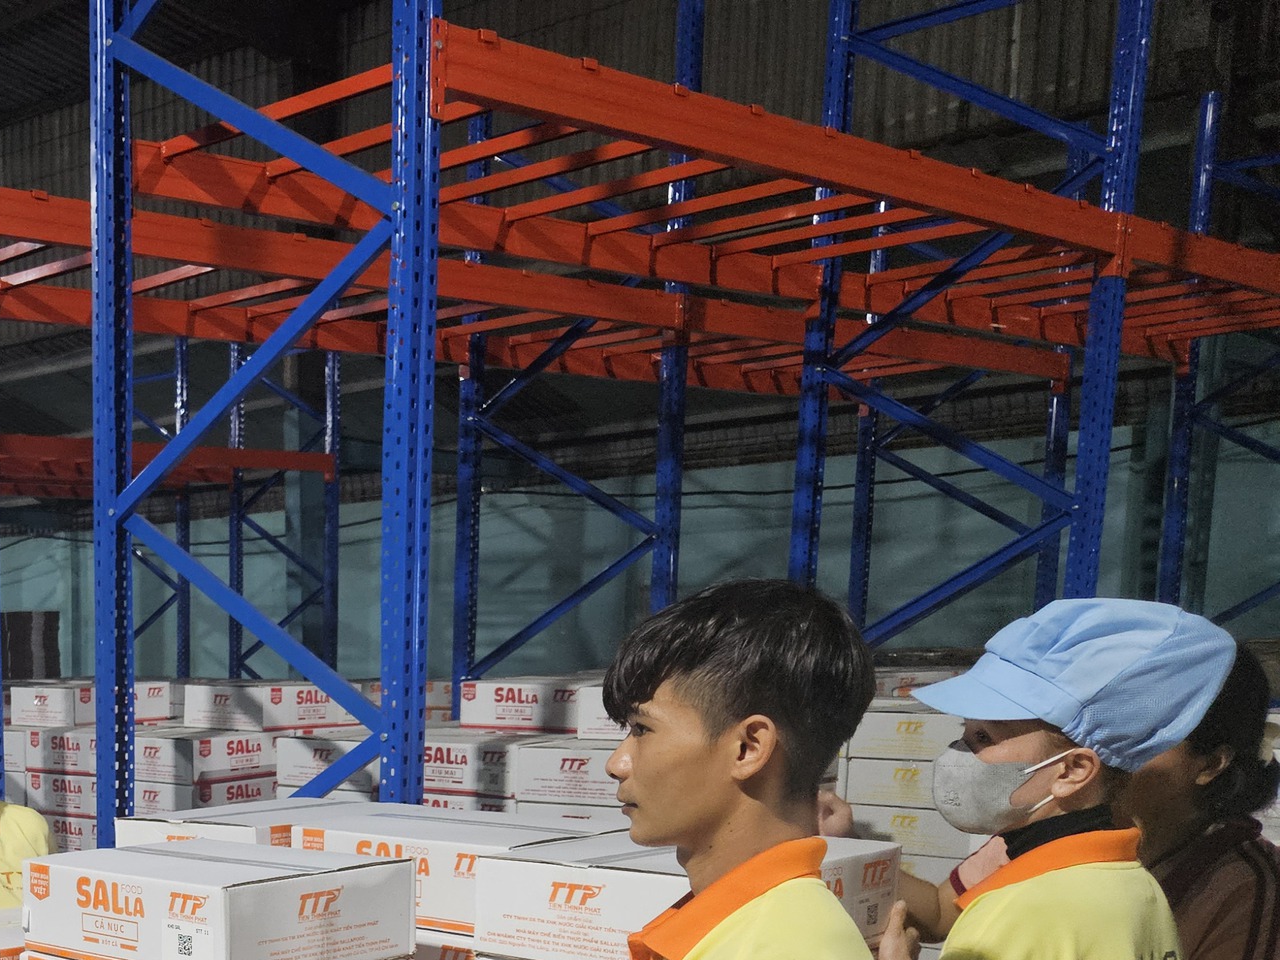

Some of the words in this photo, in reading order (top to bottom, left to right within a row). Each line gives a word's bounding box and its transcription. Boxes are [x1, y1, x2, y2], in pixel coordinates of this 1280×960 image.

[494, 687, 539, 704] SALLA
[51, 736, 80, 752] SALLA
[227, 739, 262, 756] SALLA
[424, 746, 468, 765] SALLA
[52, 779, 82, 795] SALLA
[226, 782, 262, 801] SALLA
[53, 819, 83, 836] SALLA
[76, 876, 145, 918] SALLA
[121, 884, 143, 894] FOOD
[549, 881, 603, 906] TTP
[168, 892, 207, 915] TTP
[298, 887, 343, 916] TTP
